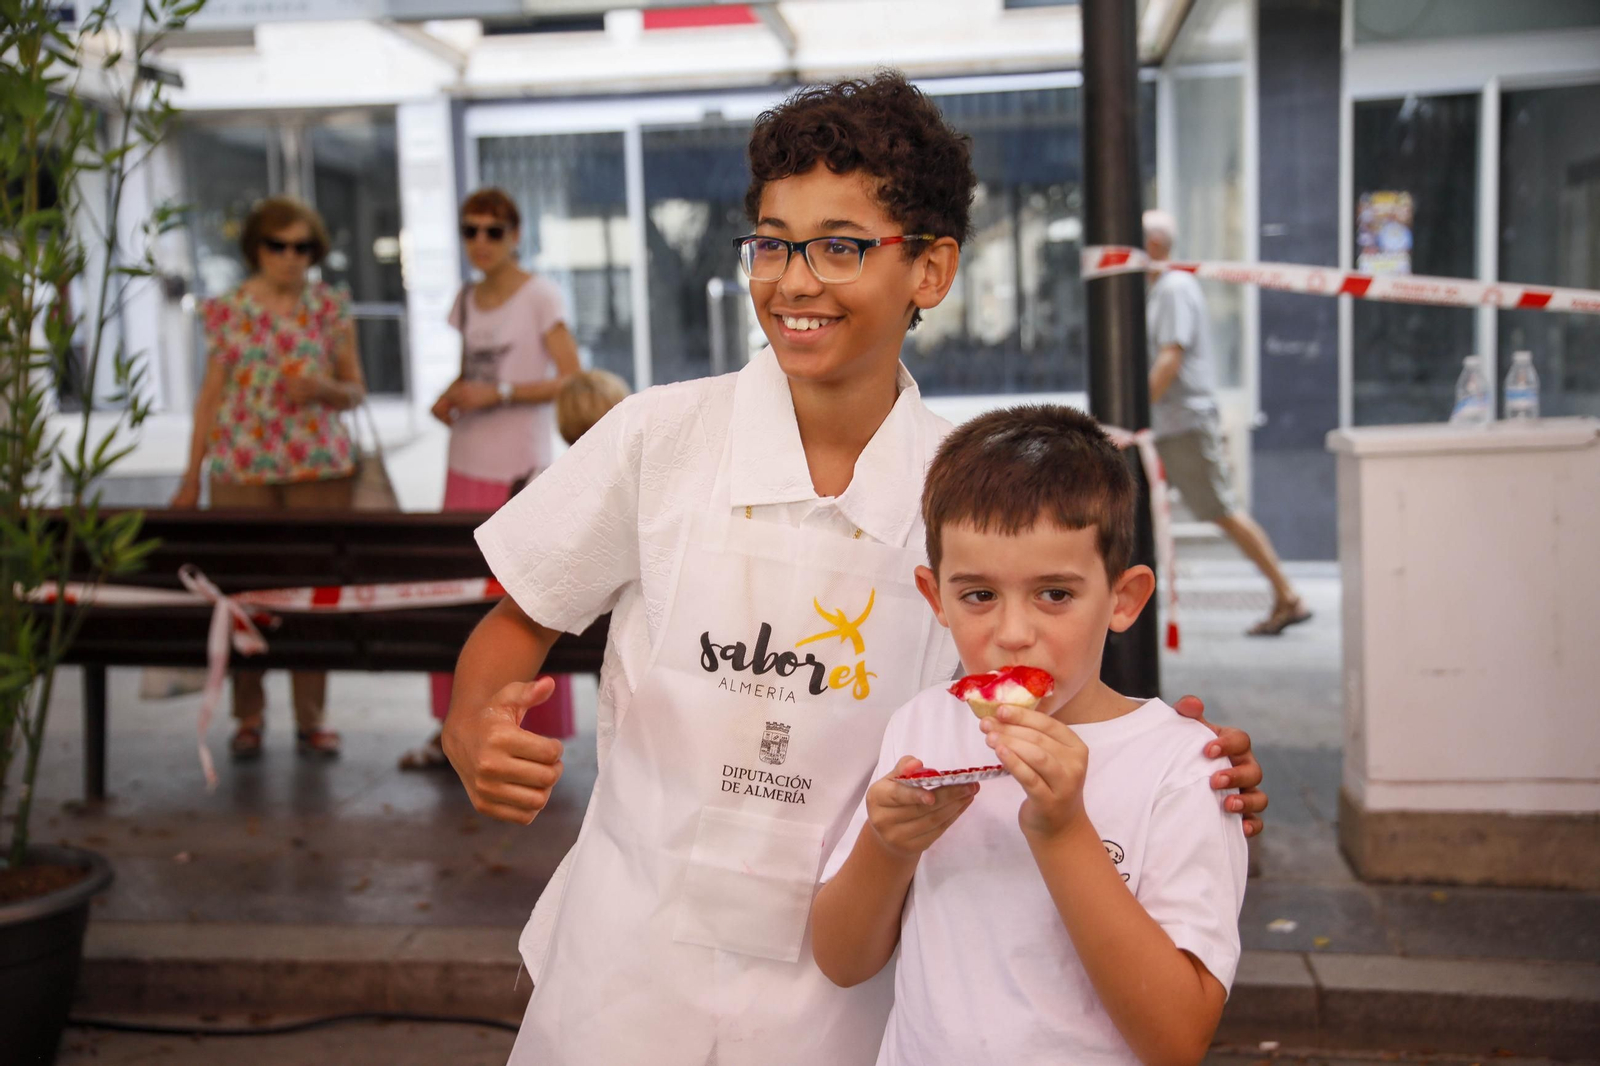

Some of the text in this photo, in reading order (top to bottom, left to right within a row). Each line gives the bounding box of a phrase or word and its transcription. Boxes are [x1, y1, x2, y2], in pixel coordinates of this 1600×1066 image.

[700, 622, 878, 700] sabores
[722, 765, 812, 790] DIPUTACIÓN
[721, 780, 806, 805] DE ALMERÍA
